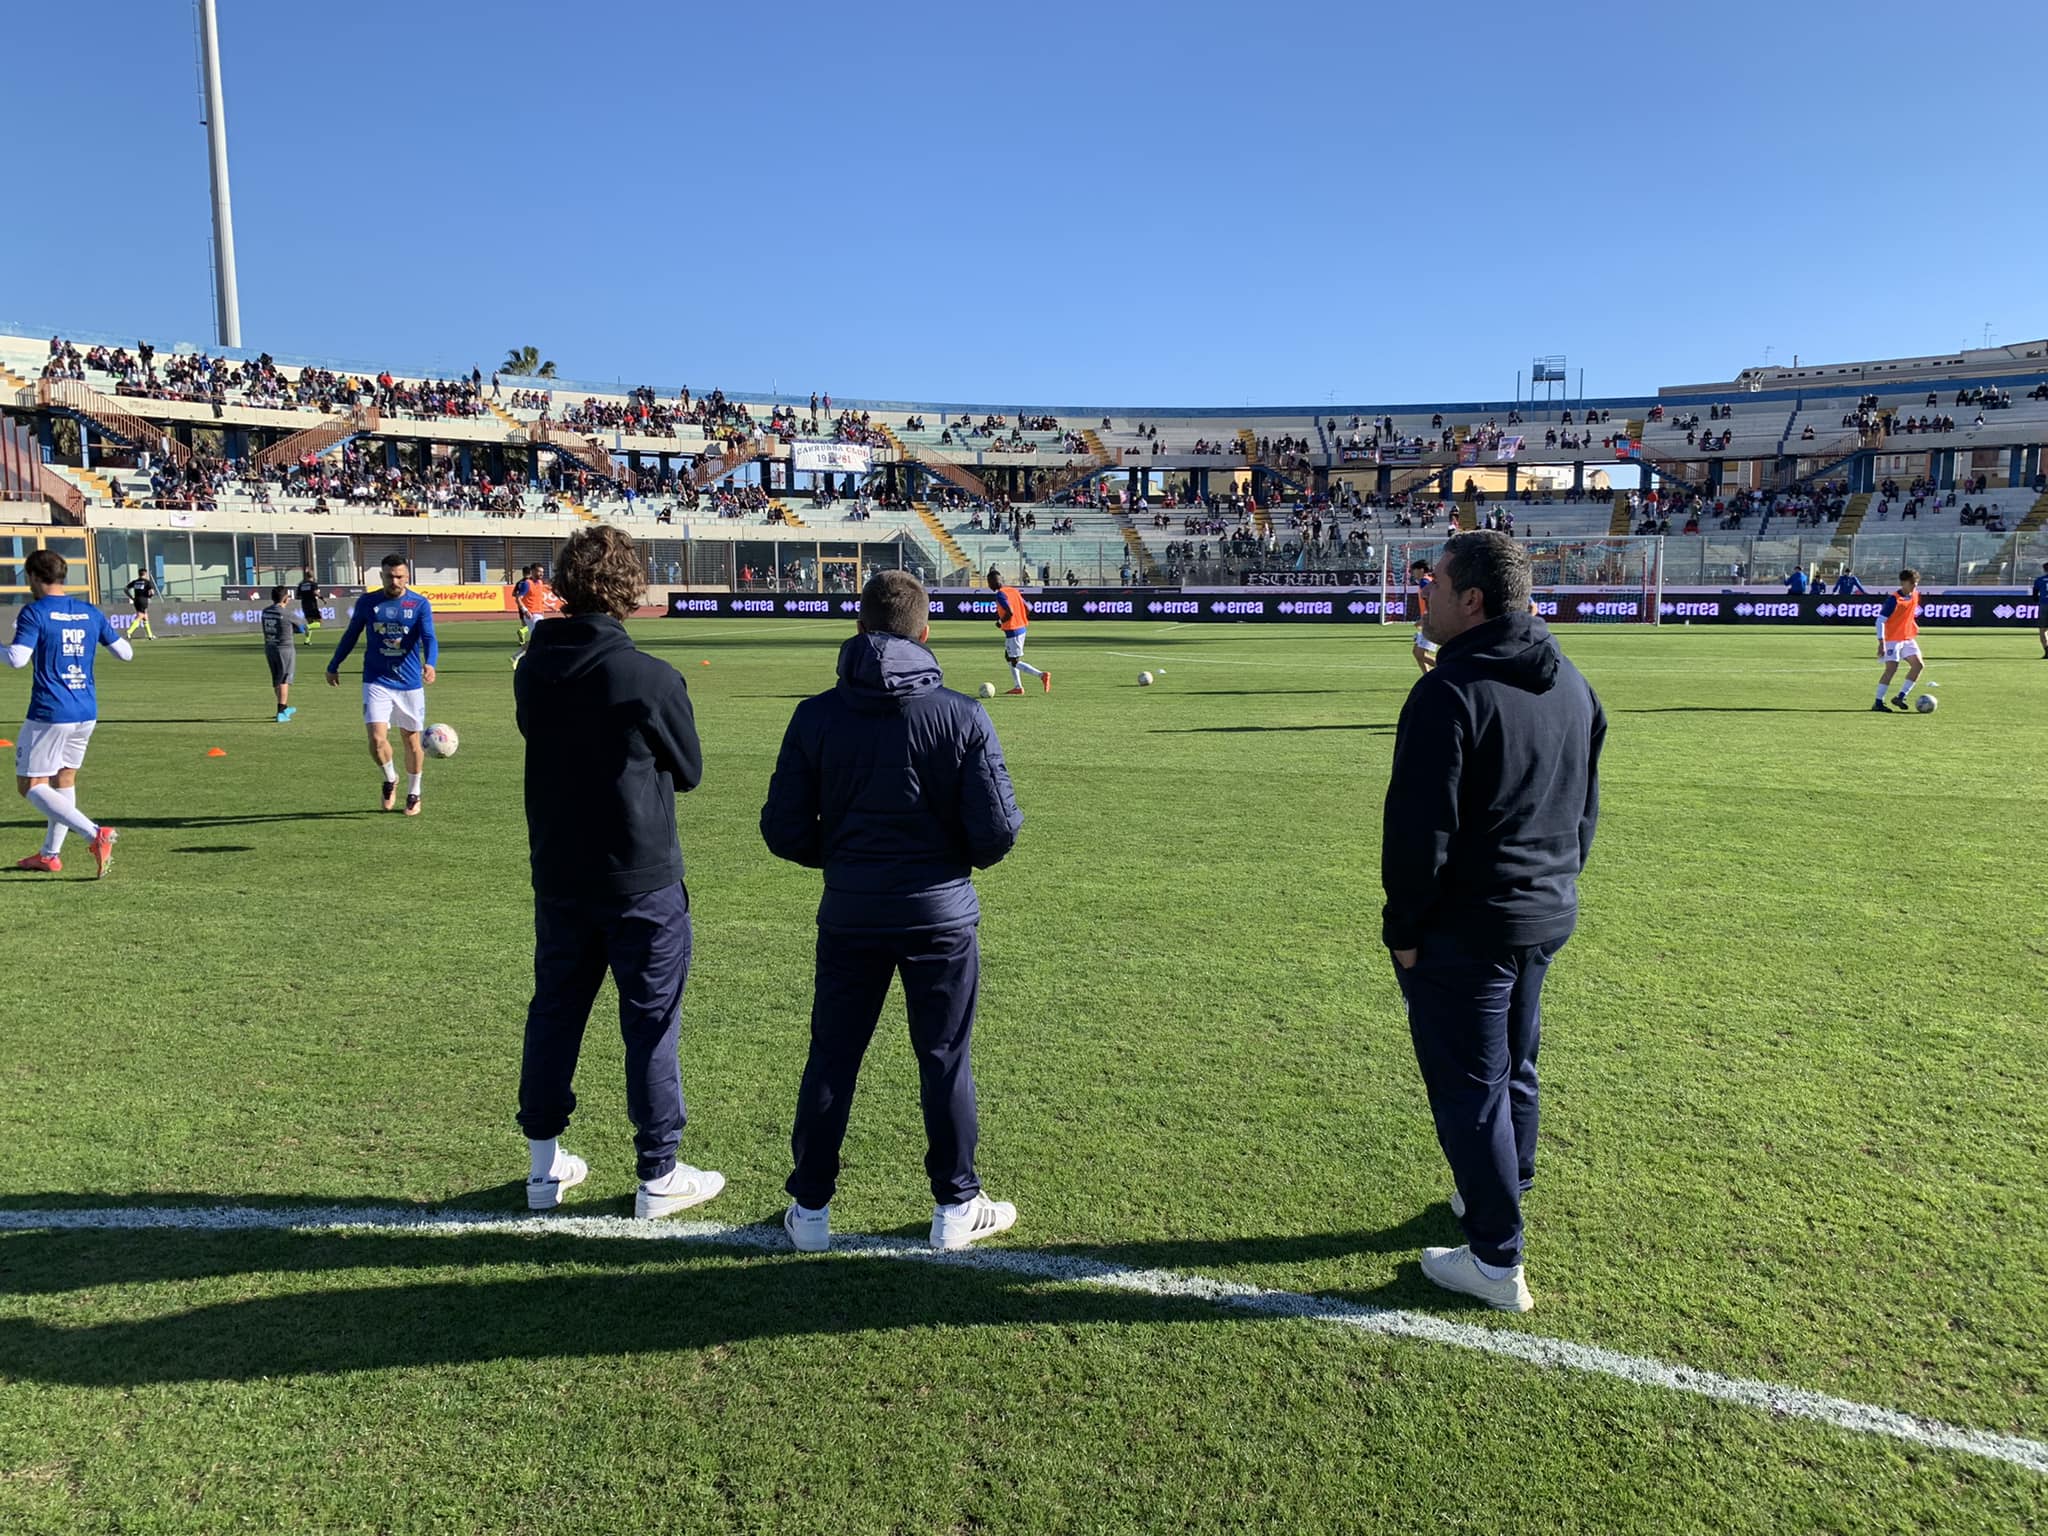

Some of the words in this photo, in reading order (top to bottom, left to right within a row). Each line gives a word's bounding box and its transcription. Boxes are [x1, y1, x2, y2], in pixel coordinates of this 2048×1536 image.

[1247, 572, 1339, 586] ESTREMA
[688, 600, 718, 611] errea
[744, 600, 775, 612] errea
[798, 600, 829, 612] errea
[972, 601, 997, 613] erre
[1034, 601, 1068, 613] errea
[1098, 601, 1133, 613] errea
[1163, 601, 1198, 614] errea
[1227, 602, 1263, 614] errea
[1294, 602, 1332, 614] errea
[1595, 602, 1637, 615] errea
[1676, 602, 1719, 616] errea
[1754, 603, 1799, 617] errea
[1837, 603, 1882, 617] errea
[1924, 604, 1972, 618] errea
[181, 611, 217, 625] errea
[62, 629, 86, 644] POP
